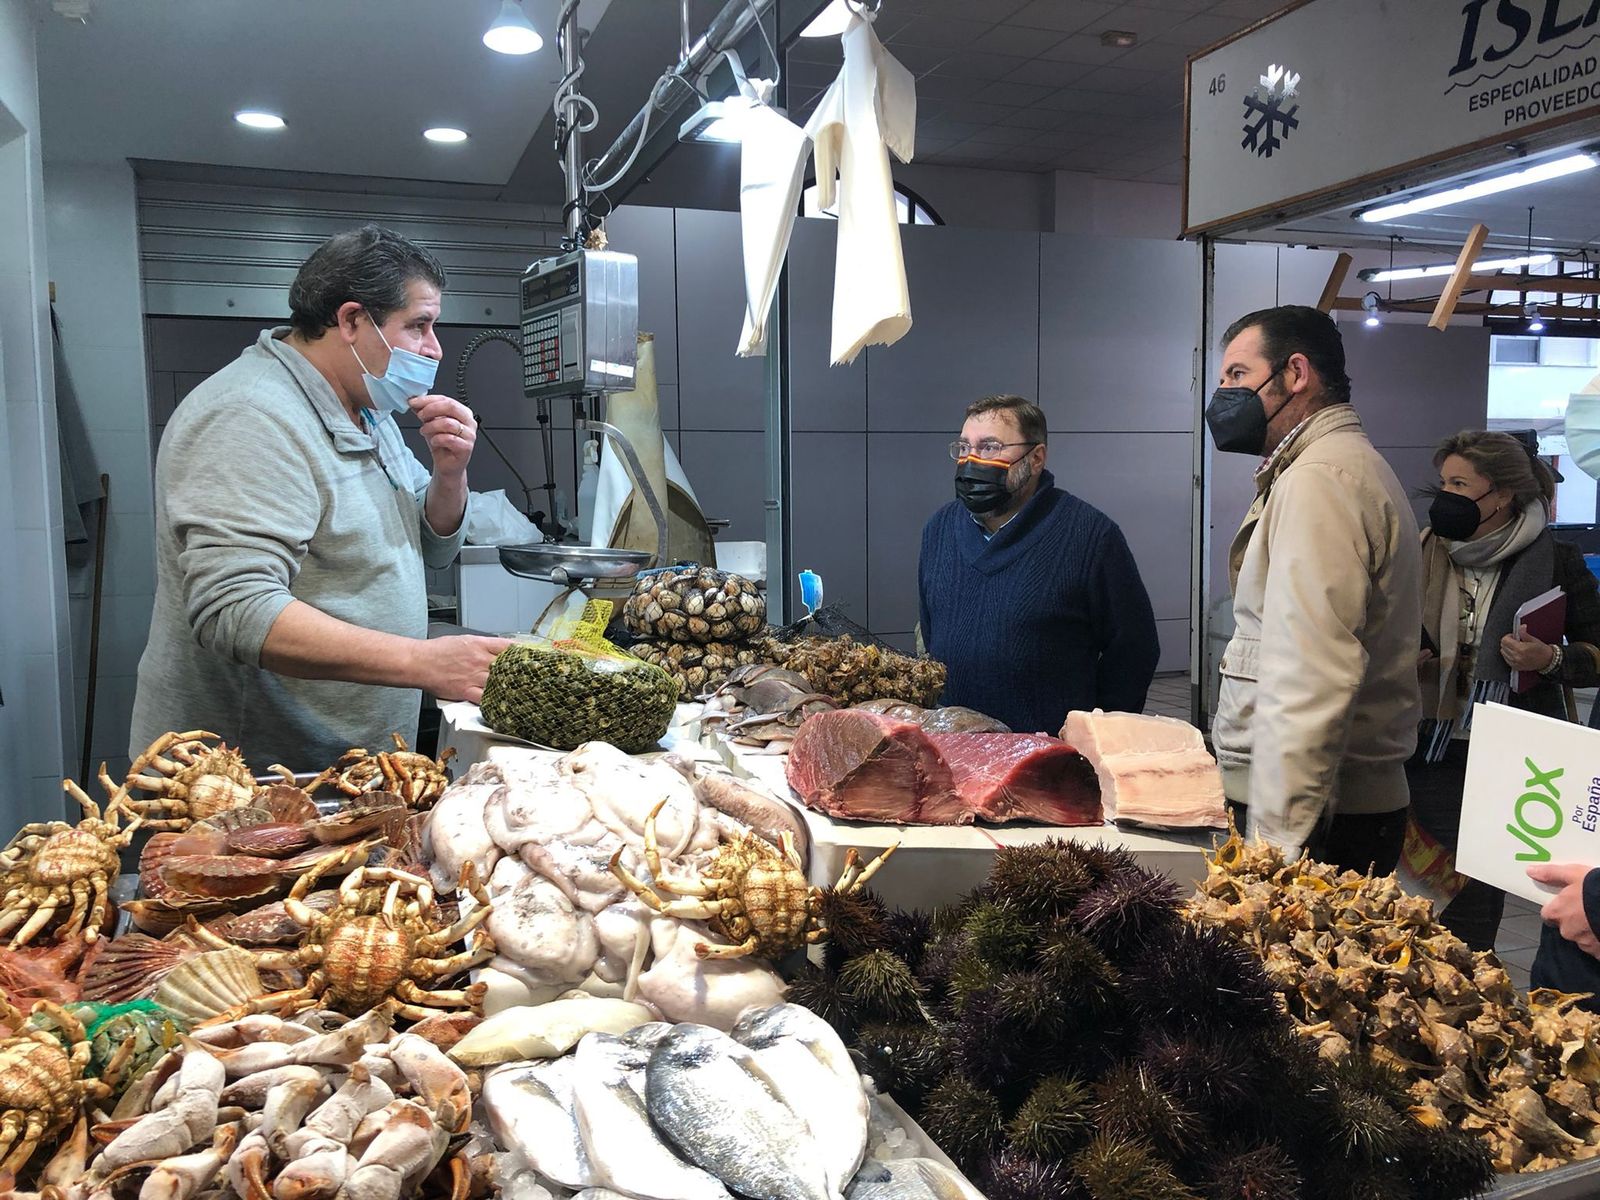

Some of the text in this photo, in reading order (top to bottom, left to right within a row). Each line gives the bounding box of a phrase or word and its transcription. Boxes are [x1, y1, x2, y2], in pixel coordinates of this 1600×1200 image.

[1208, 73, 1226, 96] 46
[1469, 56, 1597, 112] ESPECIALIDAD
[1506, 756, 1564, 862] VOX
[1571, 805, 1583, 823] Por
[1581, 776, 1600, 832] España
